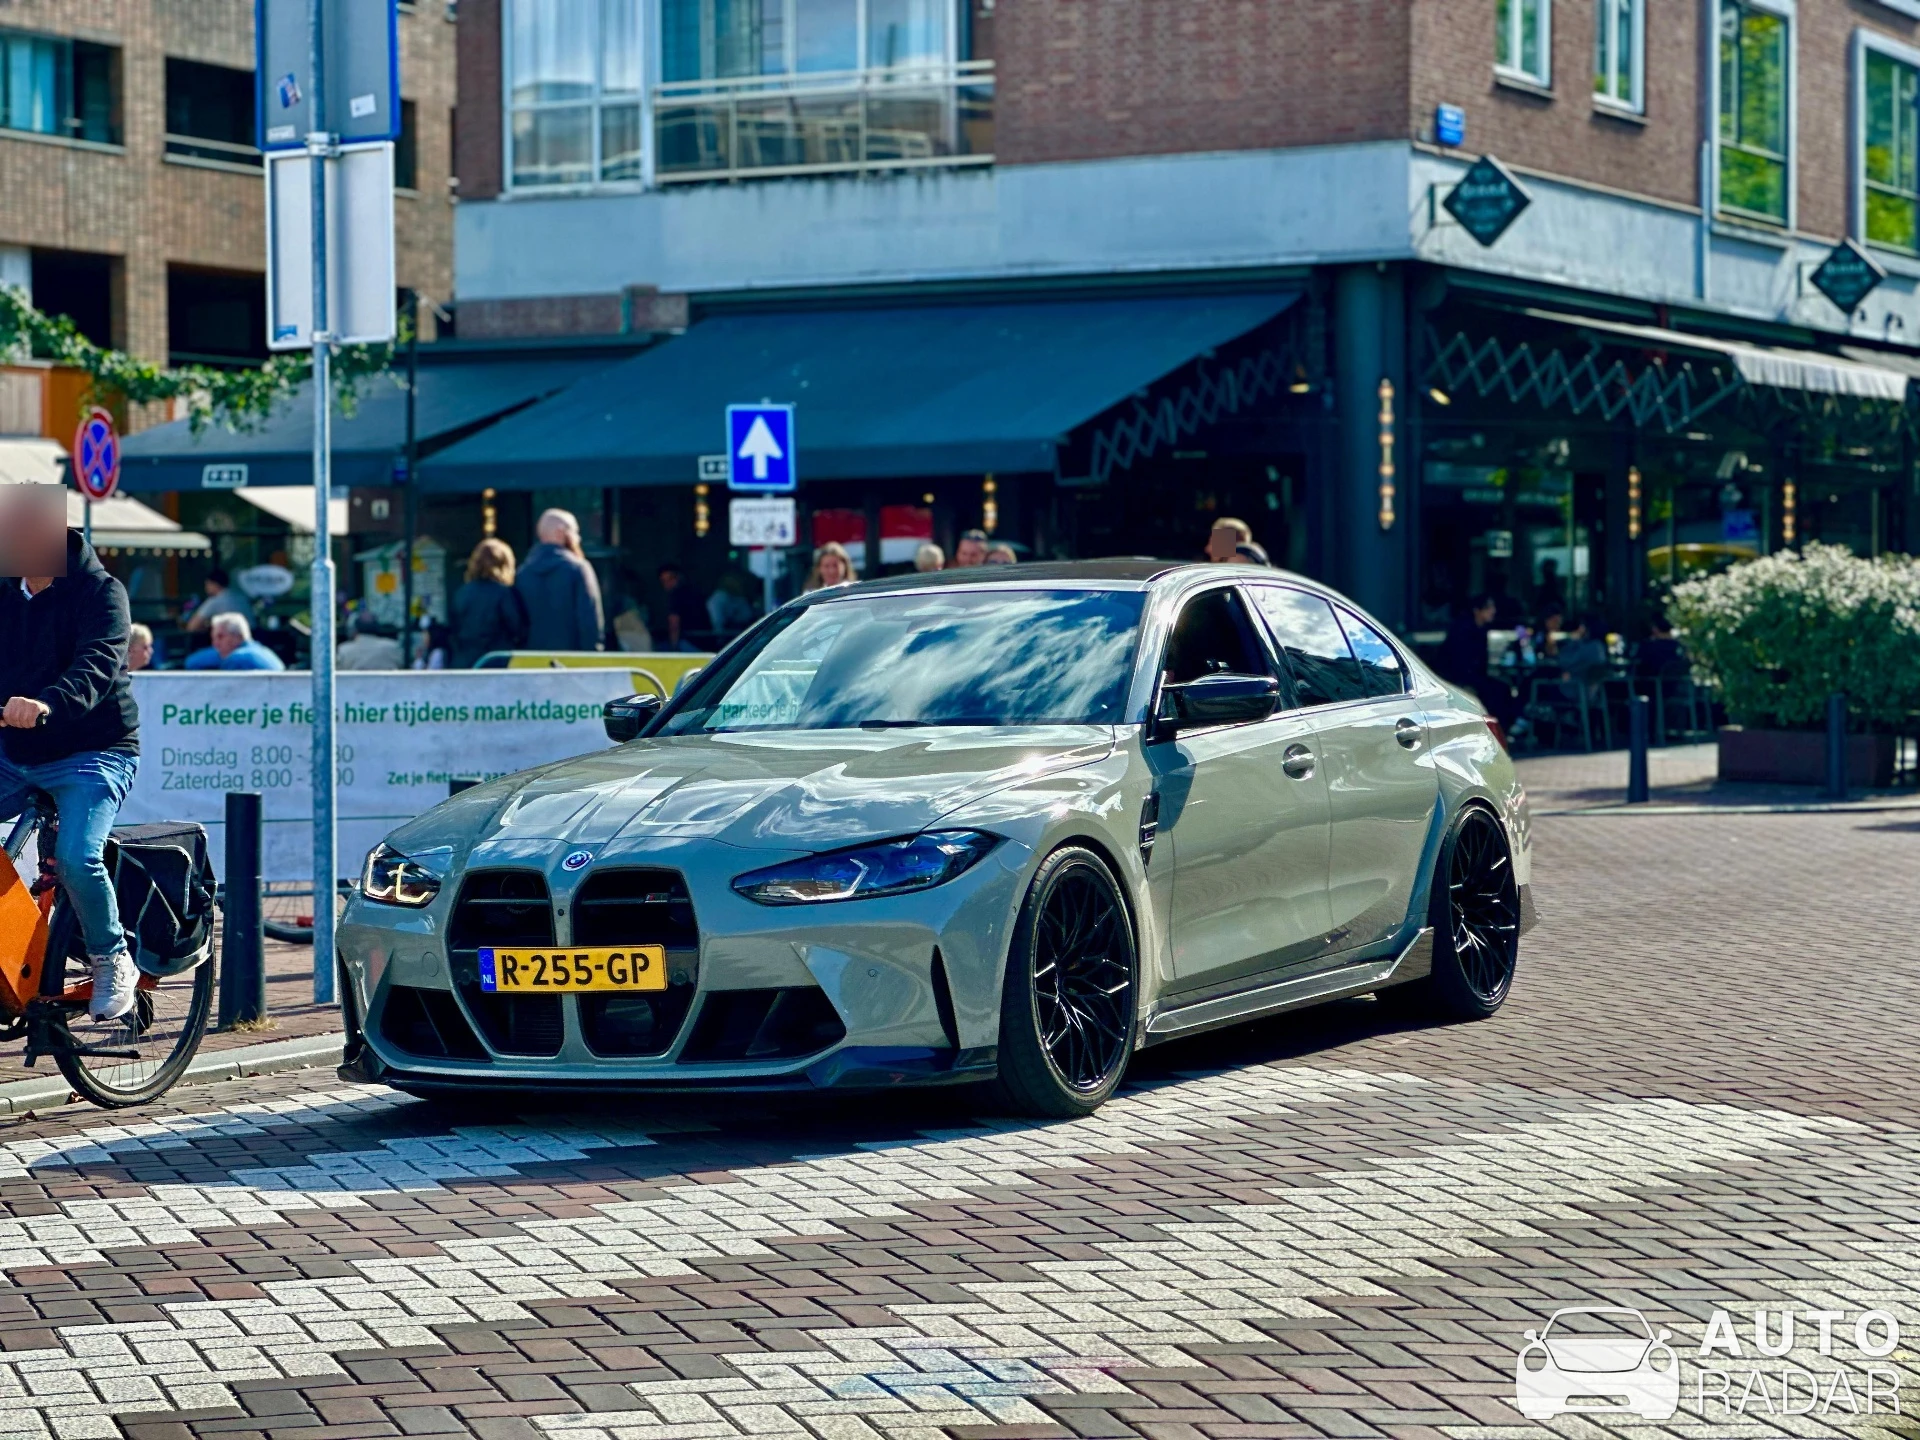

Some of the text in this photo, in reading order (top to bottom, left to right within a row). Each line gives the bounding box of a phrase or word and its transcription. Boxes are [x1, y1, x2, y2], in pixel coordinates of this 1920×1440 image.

[162, 700, 603, 728] Parkeer je fie hier tijdens marktdagen
[161, 747, 238, 769] Dinsdag
[251, 745, 292, 765] 8.00
[161, 771, 244, 791] Zaterdag
[251, 768, 292, 788] 8.00
[387, 772, 408, 785] Zet
[411, 771, 423, 786] je
[482, 974, 495, 983] NL
[501, 952, 650, 985] R-255-GP
